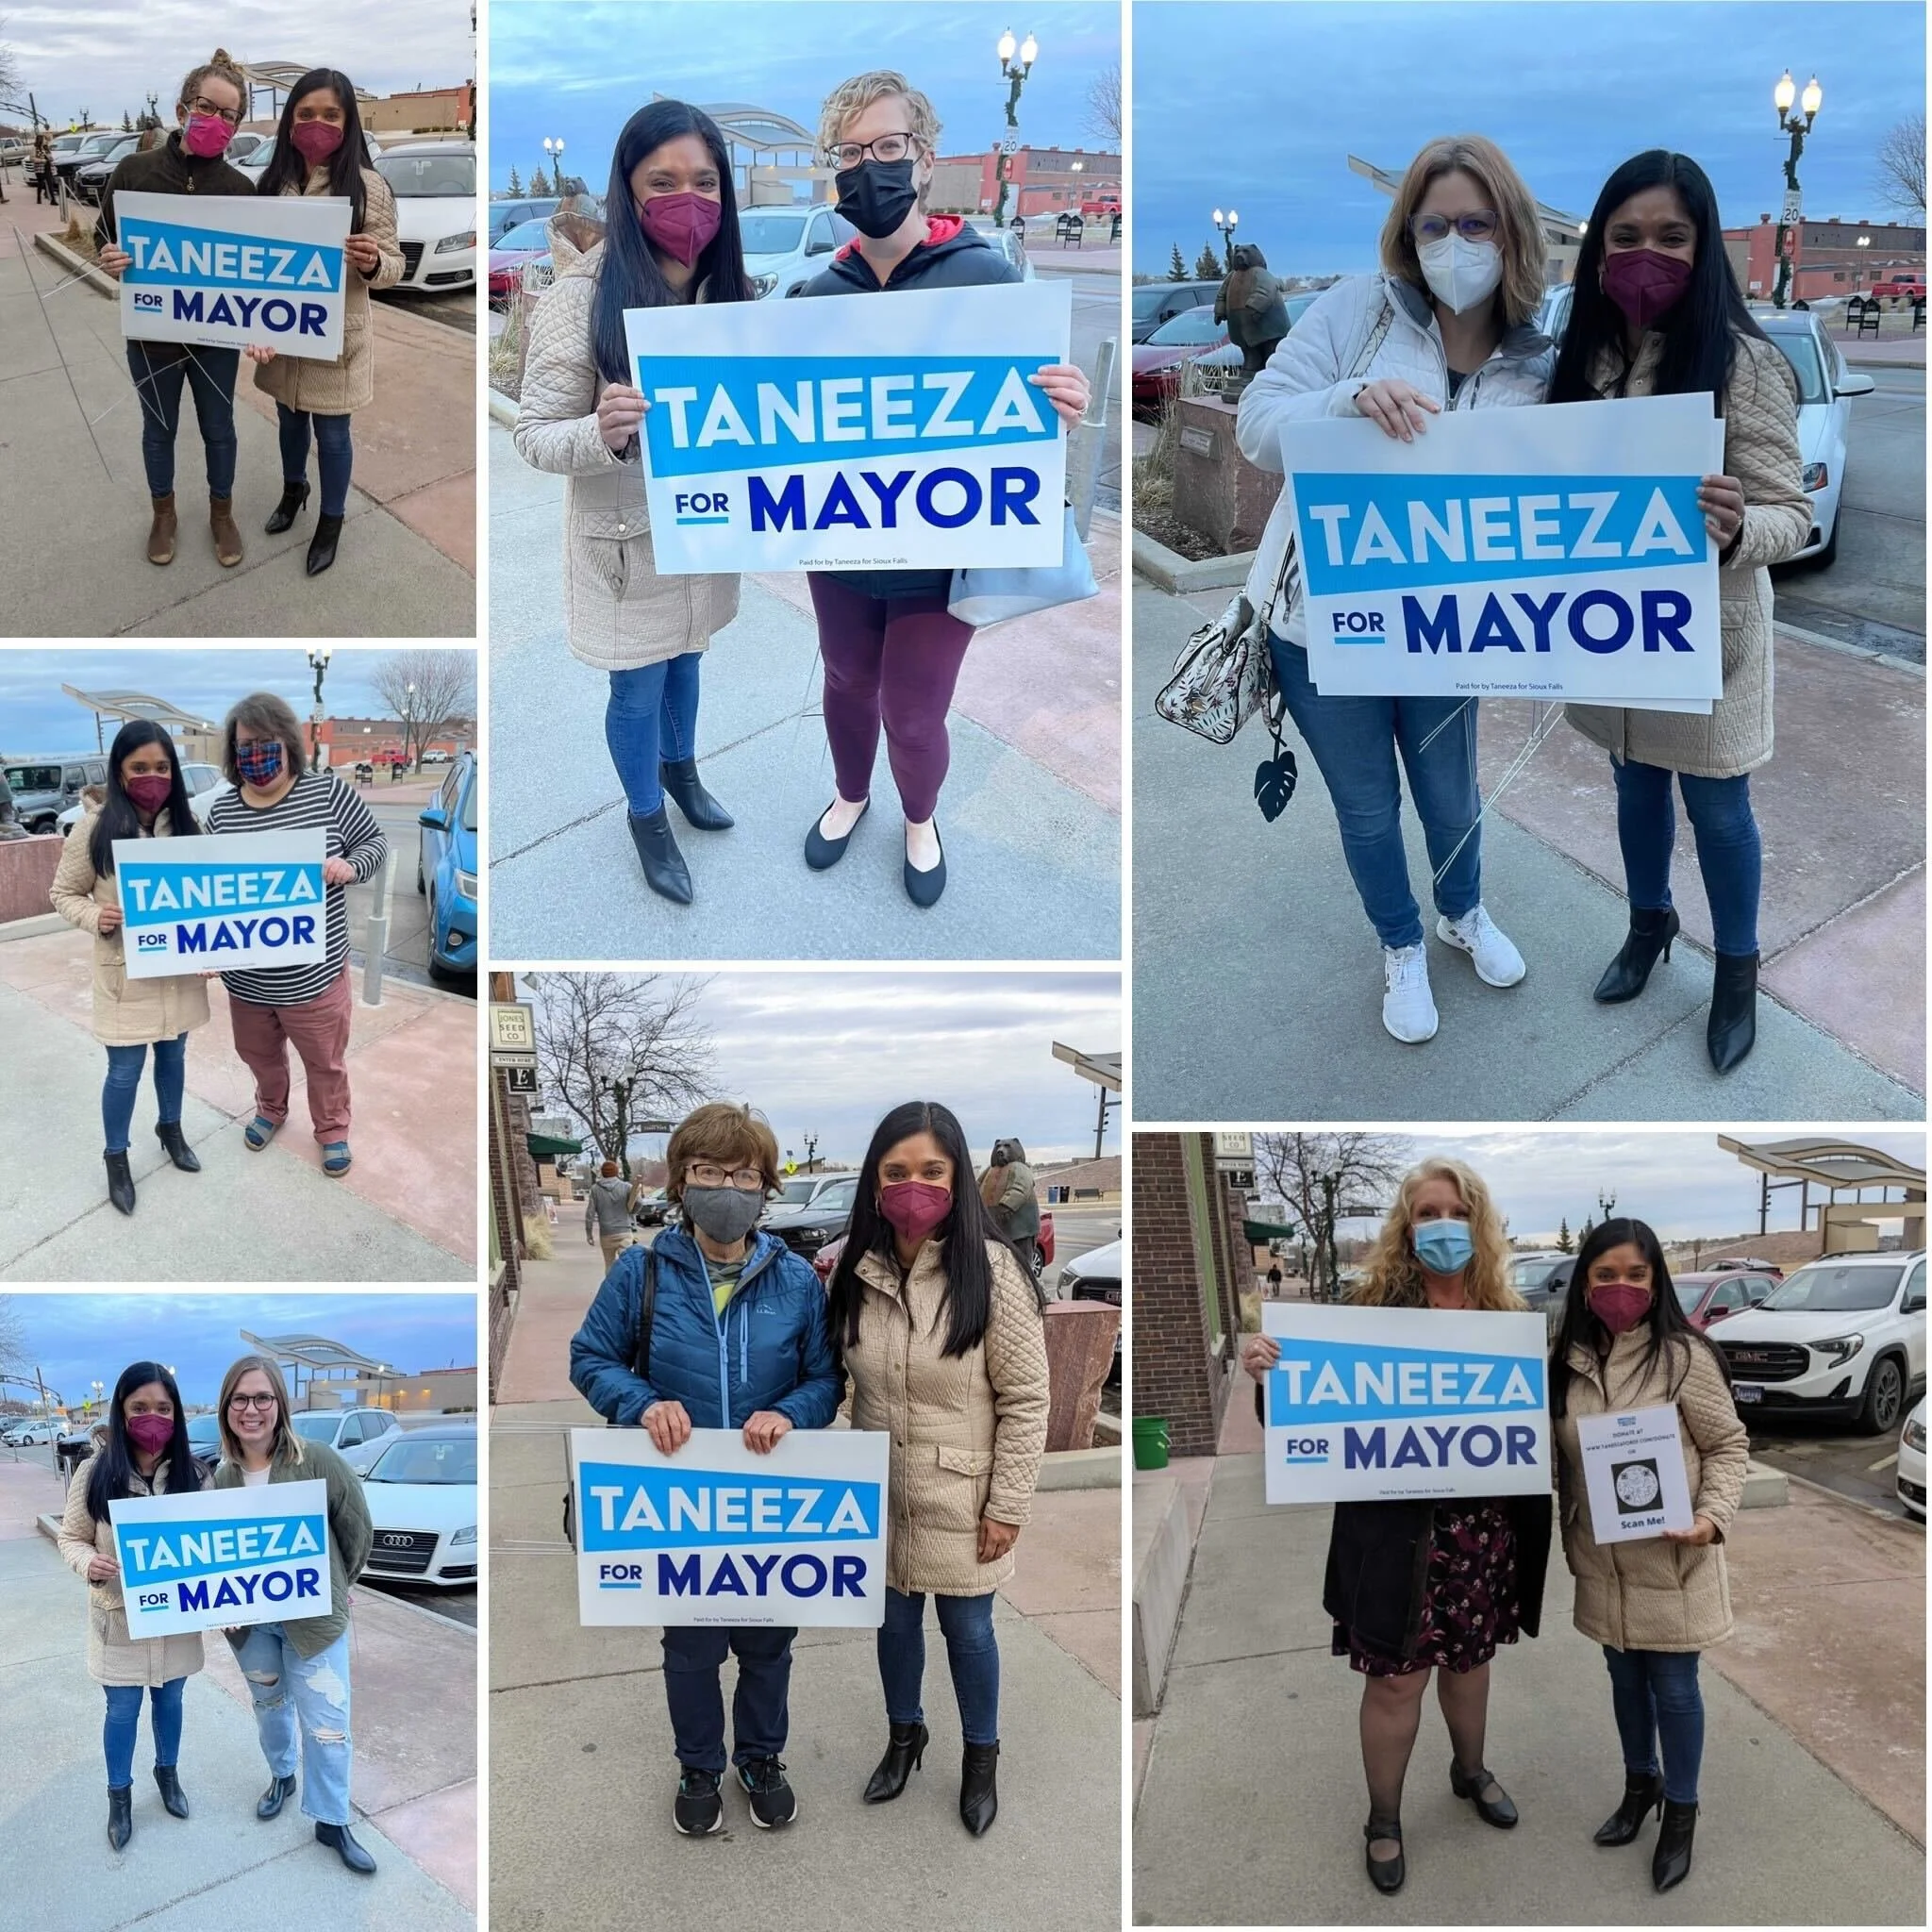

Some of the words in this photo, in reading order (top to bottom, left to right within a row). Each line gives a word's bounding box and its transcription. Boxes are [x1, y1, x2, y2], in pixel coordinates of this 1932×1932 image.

[1004, 141, 1017, 152] 20
[1784, 208, 1799, 221] 20
[127, 235, 332, 289] TANEEZA
[134, 293, 163, 308] FOR
[174, 290, 327, 337] MAYOR
[654, 366, 1046, 449] TANEEZA
[675, 492, 730, 514] FOR
[747, 467, 1041, 533] MAYOR
[1308, 487, 1694, 567] TANEEZA
[824, 558, 833, 567] by
[1331, 611, 1386, 633] FOR
[1402, 590, 1695, 655] MAYOR
[1481, 682, 1490, 691] by
[127, 868, 318, 912] TANEEZA
[138, 934, 167, 946] FOR
[176, 915, 316, 955] MAYOR
[498, 1024, 525, 1032] SEED
[1278, 1359, 1537, 1405] TANEEZA
[1287, 1438, 1329, 1455] FOR
[1344, 1424, 1538, 1471] MAYOR
[590, 1484, 871, 1534] TANEEZA
[1621, 1519, 1644, 1529] Scan
[1647, 1516, 1665, 1525] Me!
[125, 1520, 320, 1572] TANEEZA
[139, 1592, 169, 1606] FOR
[177, 1567, 321, 1613] MAYOR
[600, 1564, 642, 1580] FOR
[658, 1553, 867, 1598] MAYOR
